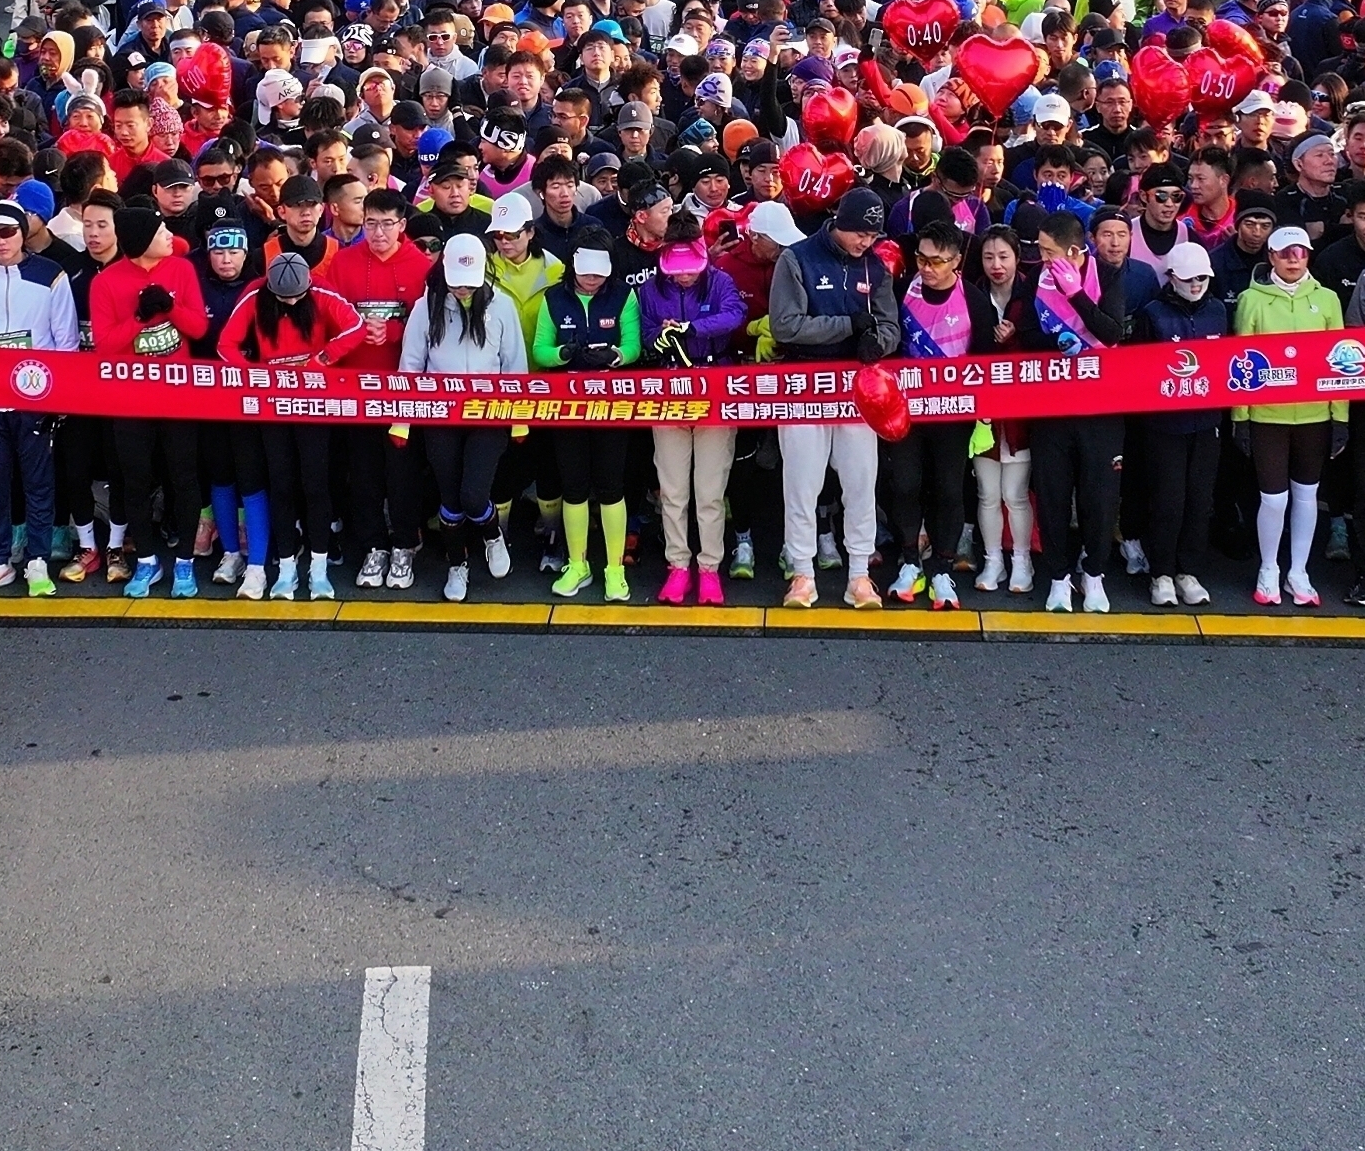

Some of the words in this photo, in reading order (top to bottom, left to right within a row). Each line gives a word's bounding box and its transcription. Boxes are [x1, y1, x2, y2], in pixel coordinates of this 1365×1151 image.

[907, 21, 942, 47] 0:40
[180, 64, 207, 95] 1:00
[1200, 69, 1235, 101] 0:50
[798, 168, 834, 199] 0:45
[138, 328, 180, 349] A0319
[1258, 367, 1297, 382] 泉阳泉
